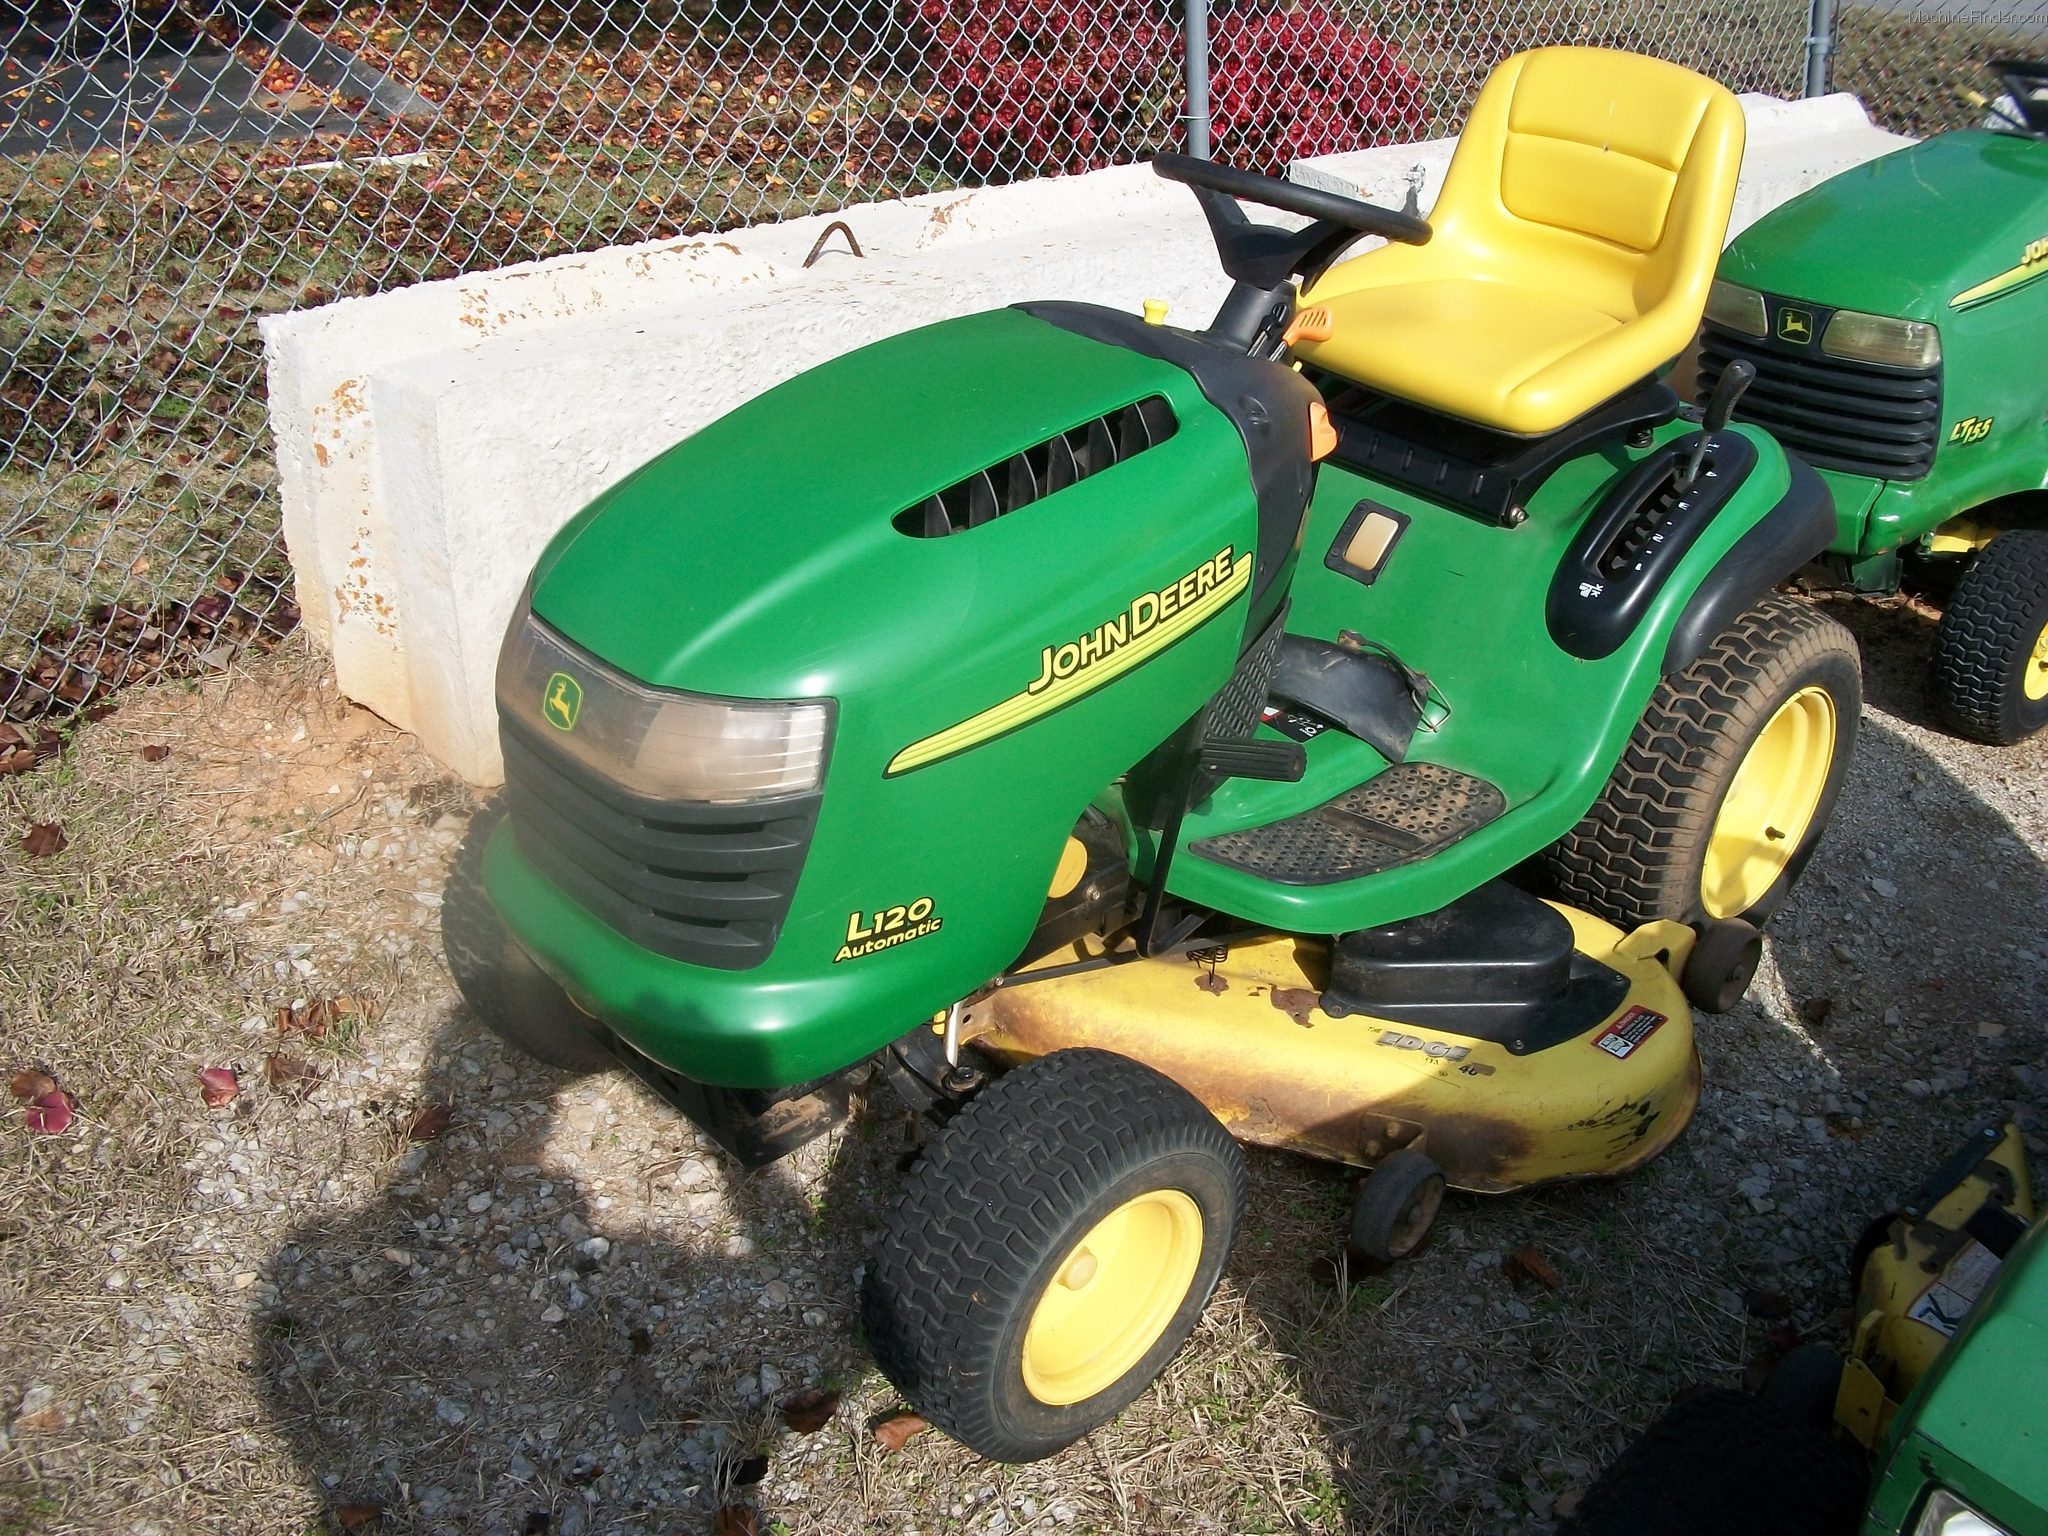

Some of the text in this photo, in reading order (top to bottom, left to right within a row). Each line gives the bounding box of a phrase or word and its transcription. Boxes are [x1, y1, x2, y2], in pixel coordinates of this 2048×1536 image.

[1948, 417, 1994, 444] LT155
[1028, 544, 1234, 695] JOHN DEERE
[833, 918, 943, 963] Automatic
[846, 897, 935, 942] L120
[1376, 1031, 1472, 1061] EDGE
